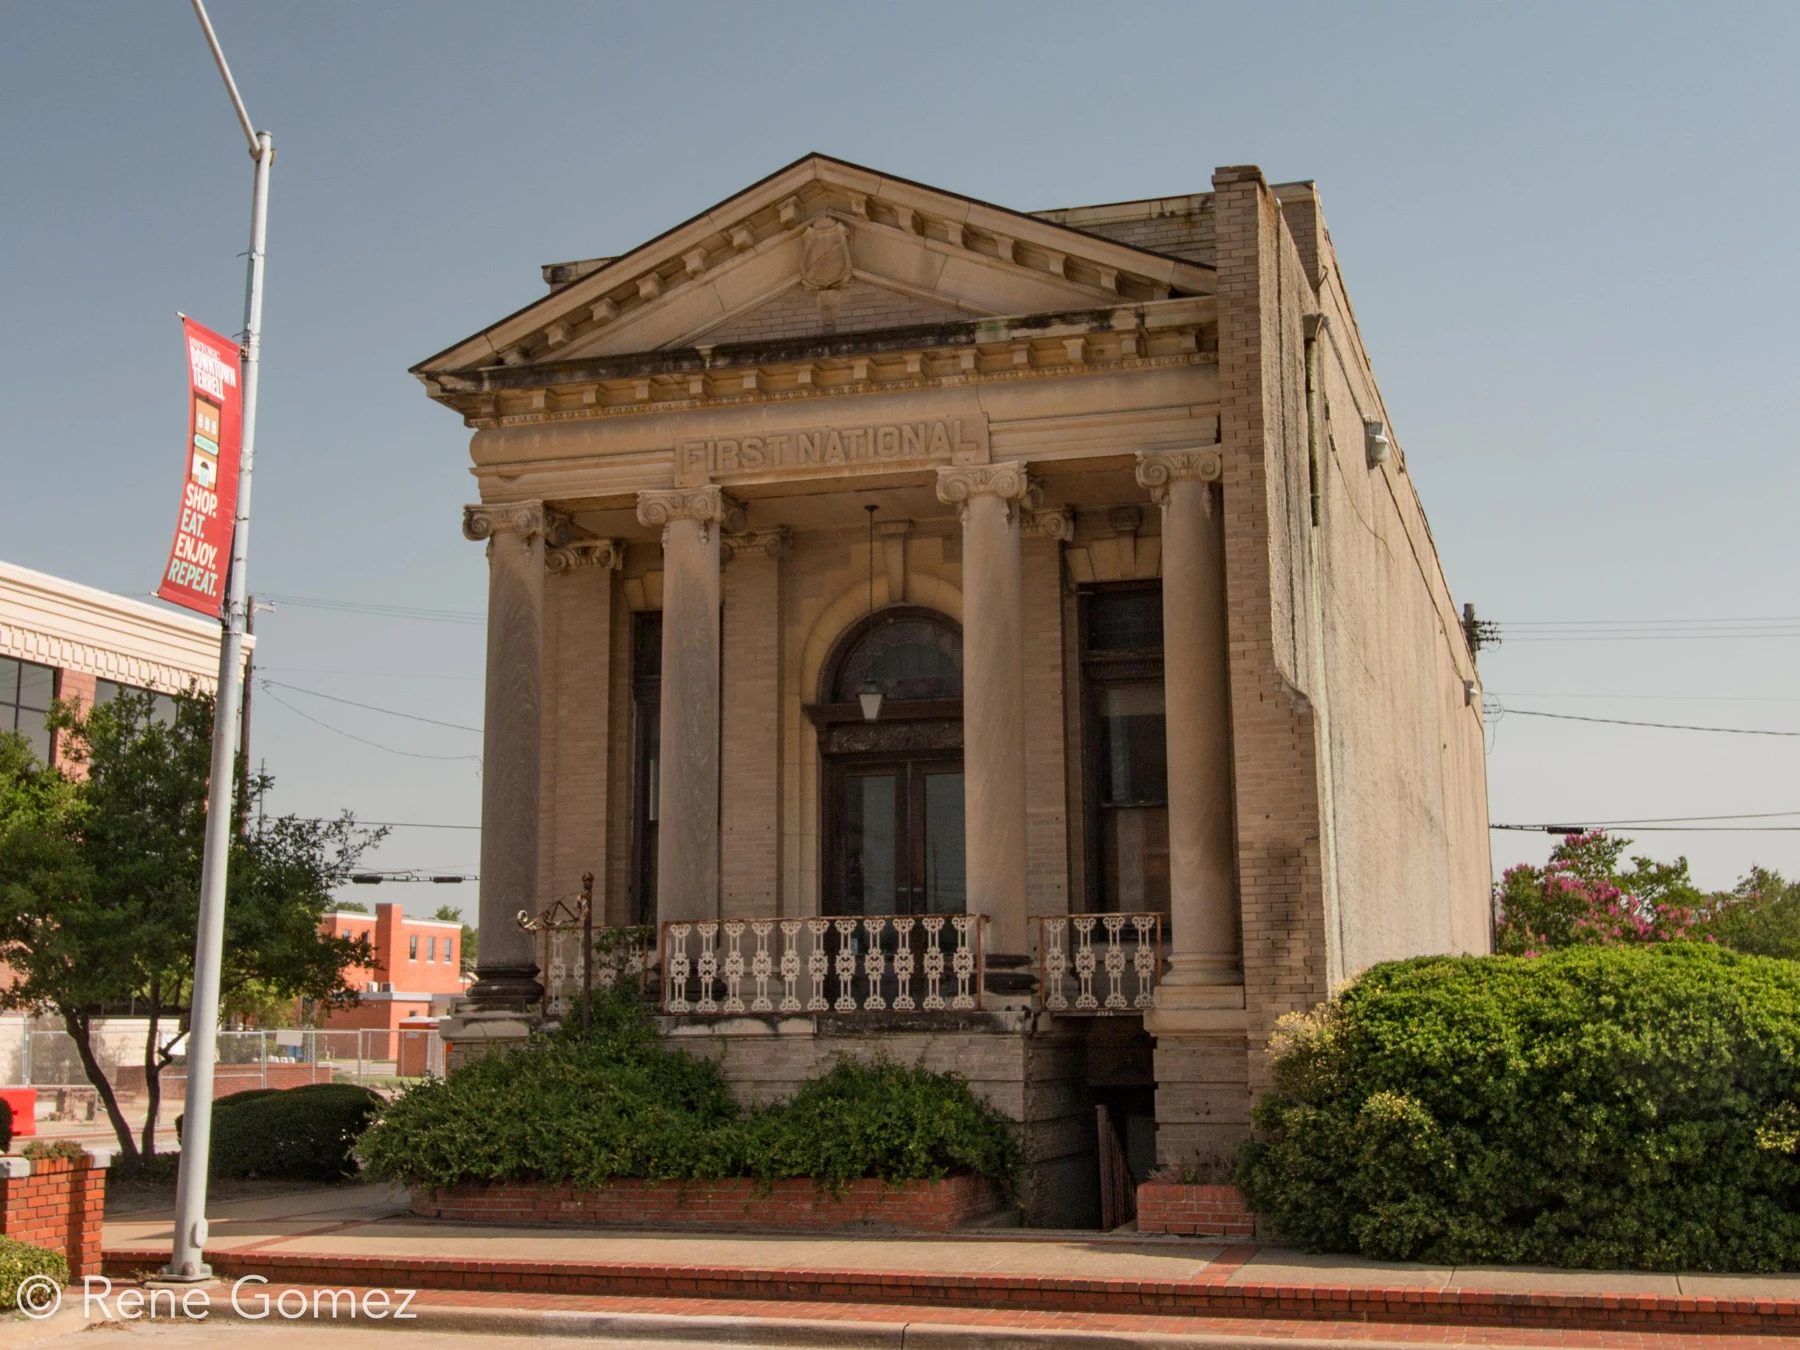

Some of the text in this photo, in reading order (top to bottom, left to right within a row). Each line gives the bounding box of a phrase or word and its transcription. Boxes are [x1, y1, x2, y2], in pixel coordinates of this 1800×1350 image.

[190, 347, 236, 388] DOWNTOWN
[192, 366, 225, 401] TERRELL
[683, 420, 977, 473] FIRST NATIONAL
[185, 483, 218, 518] SHOP.
[180, 508, 206, 539] EAT.
[175, 533, 218, 570] ENJOY.
[167, 558, 219, 597] REPEAT.
